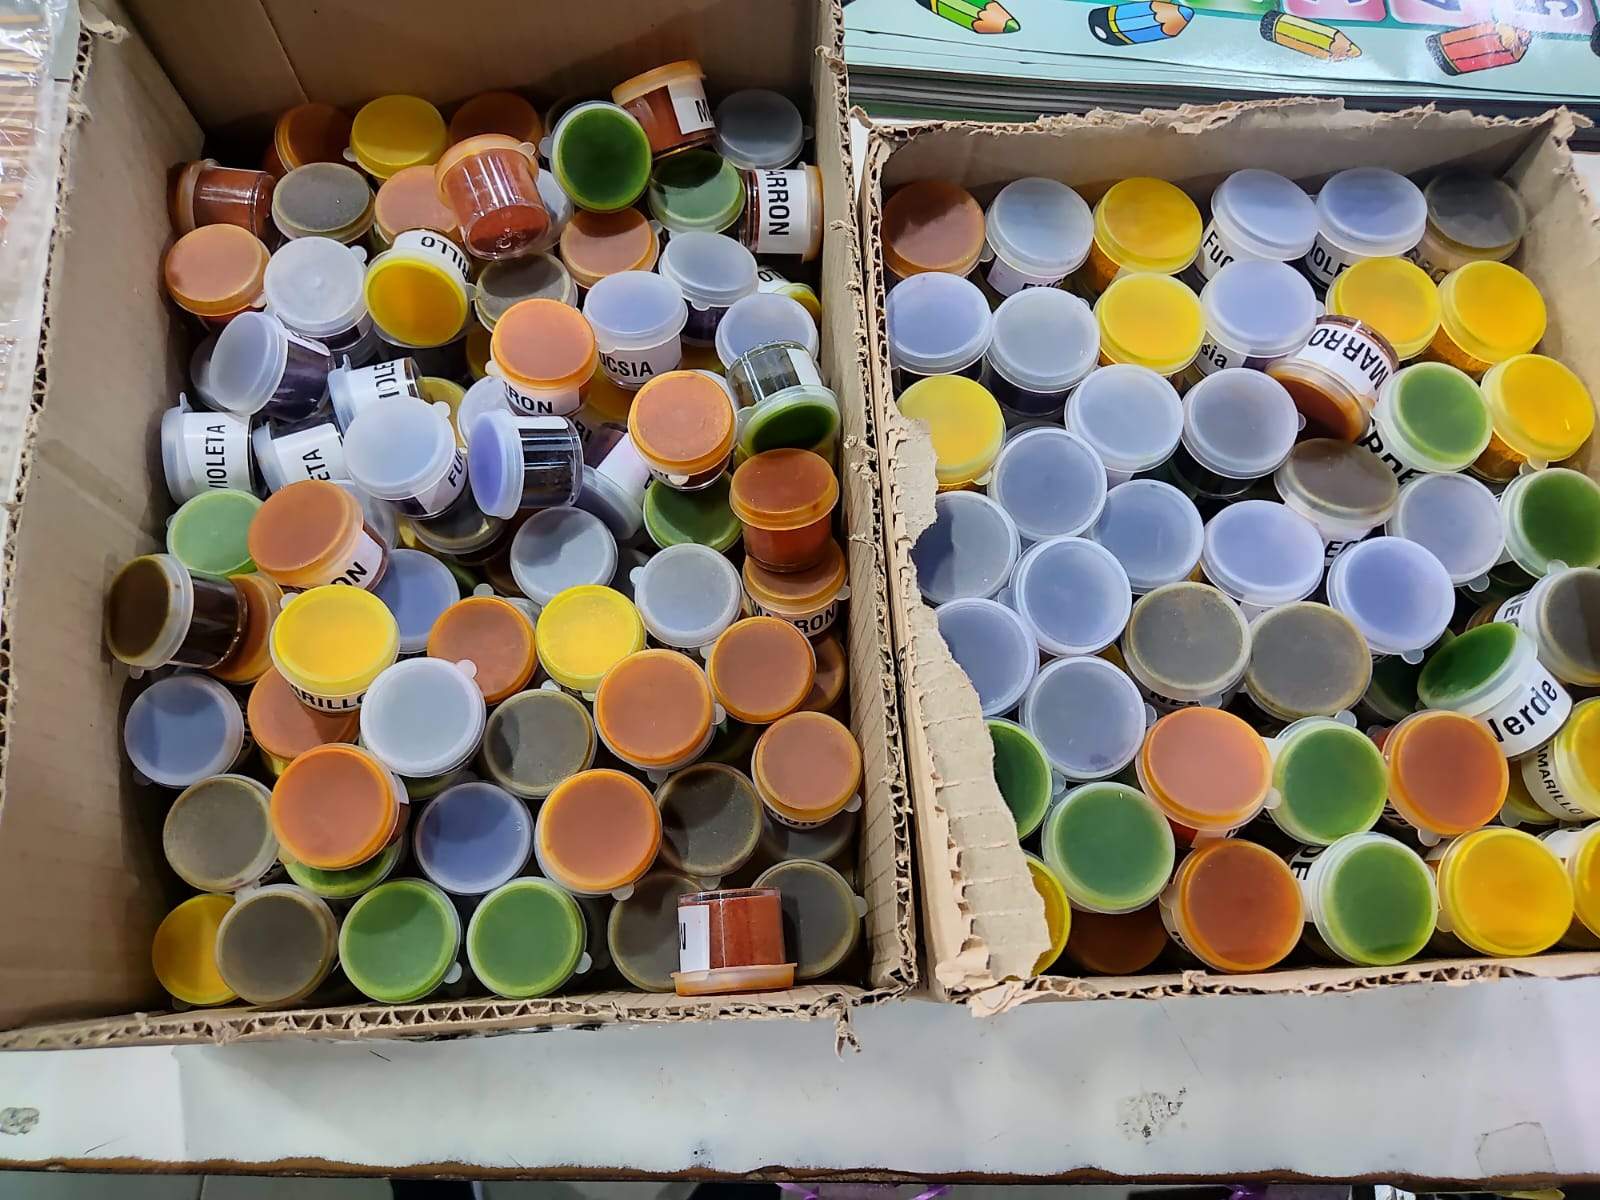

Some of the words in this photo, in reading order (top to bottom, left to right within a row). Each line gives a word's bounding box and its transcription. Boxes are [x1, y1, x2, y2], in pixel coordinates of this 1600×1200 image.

[766, 169, 790, 236] ARRON
[421, 236, 471, 283] RILLO
[599, 351, 653, 377] UCSIA
[1308, 328, 1389, 390] MARRO
[1537, 745, 1583, 815] MARILLO
